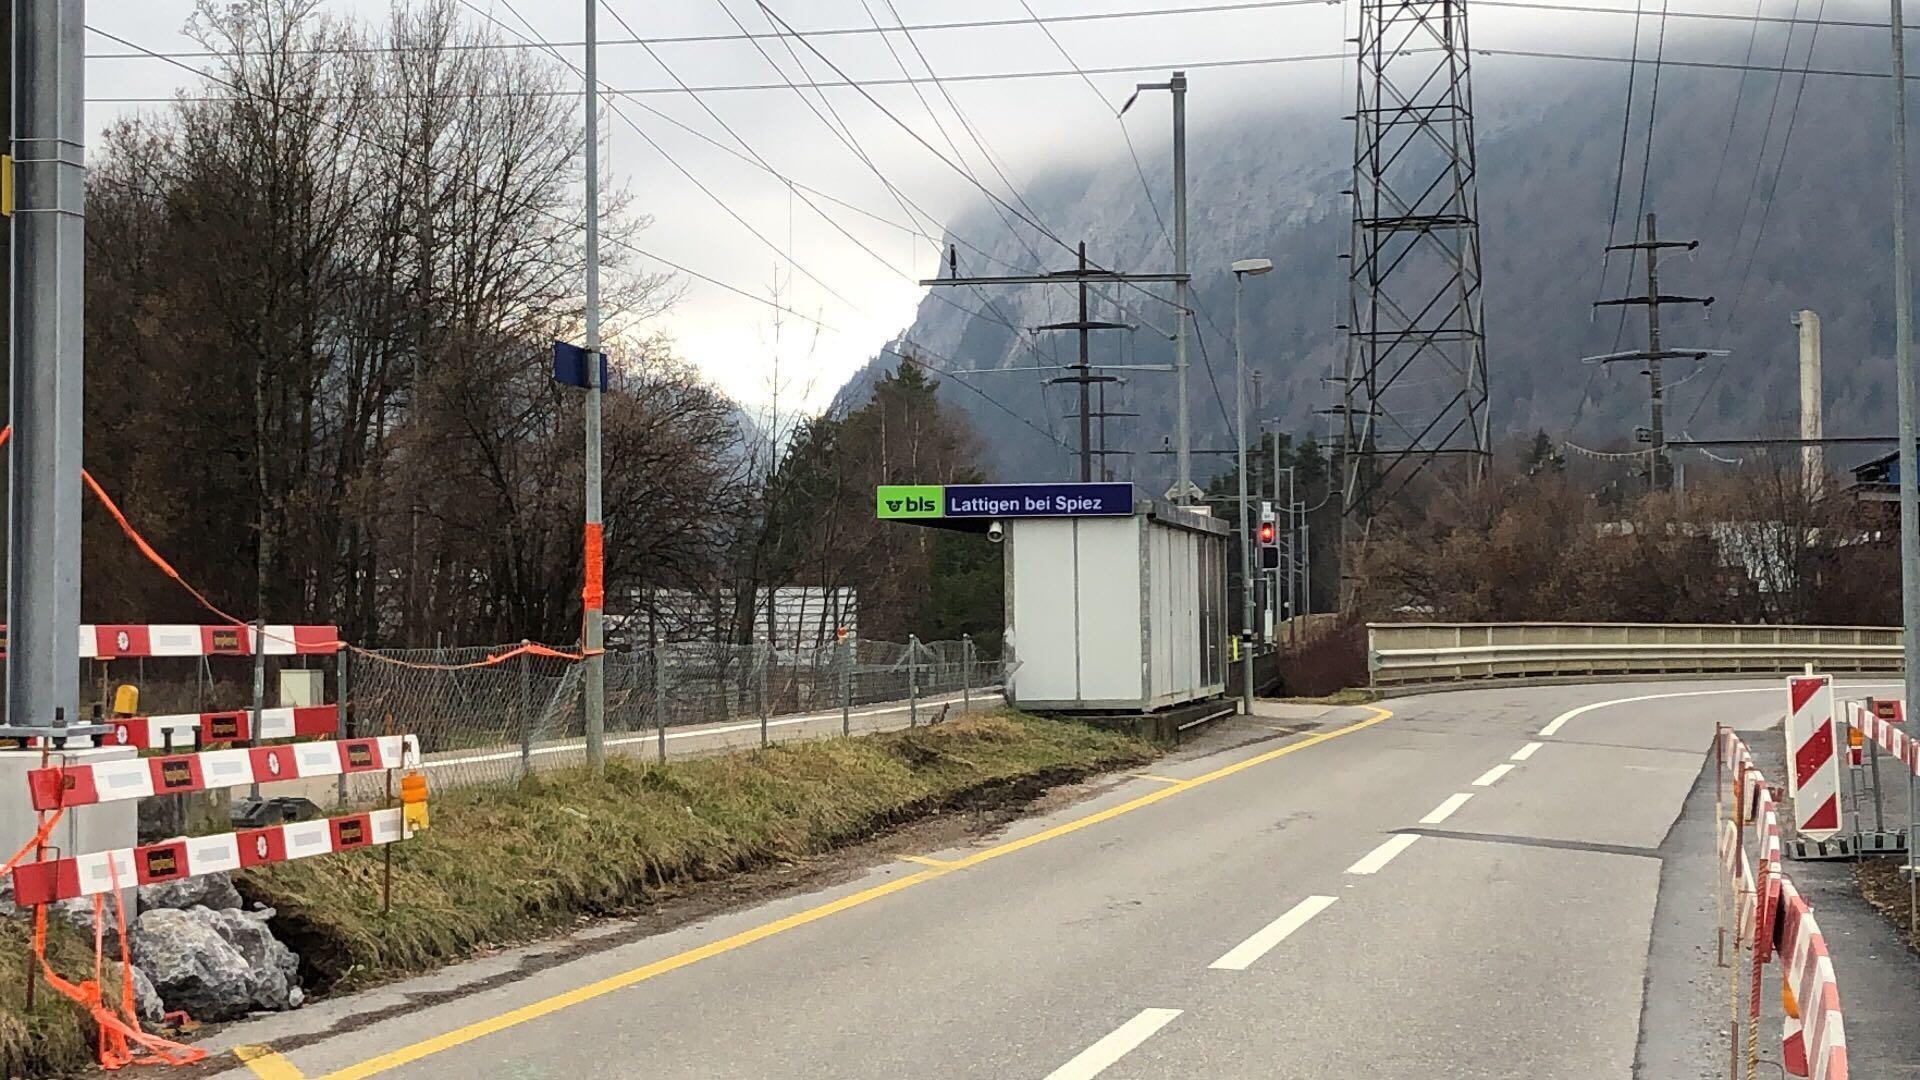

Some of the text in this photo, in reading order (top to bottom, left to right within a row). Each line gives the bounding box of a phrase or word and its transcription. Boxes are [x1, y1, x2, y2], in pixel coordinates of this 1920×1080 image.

[906, 496, 936, 512] bls
[951, 495, 1102, 514] Lattigen bei Spiez
